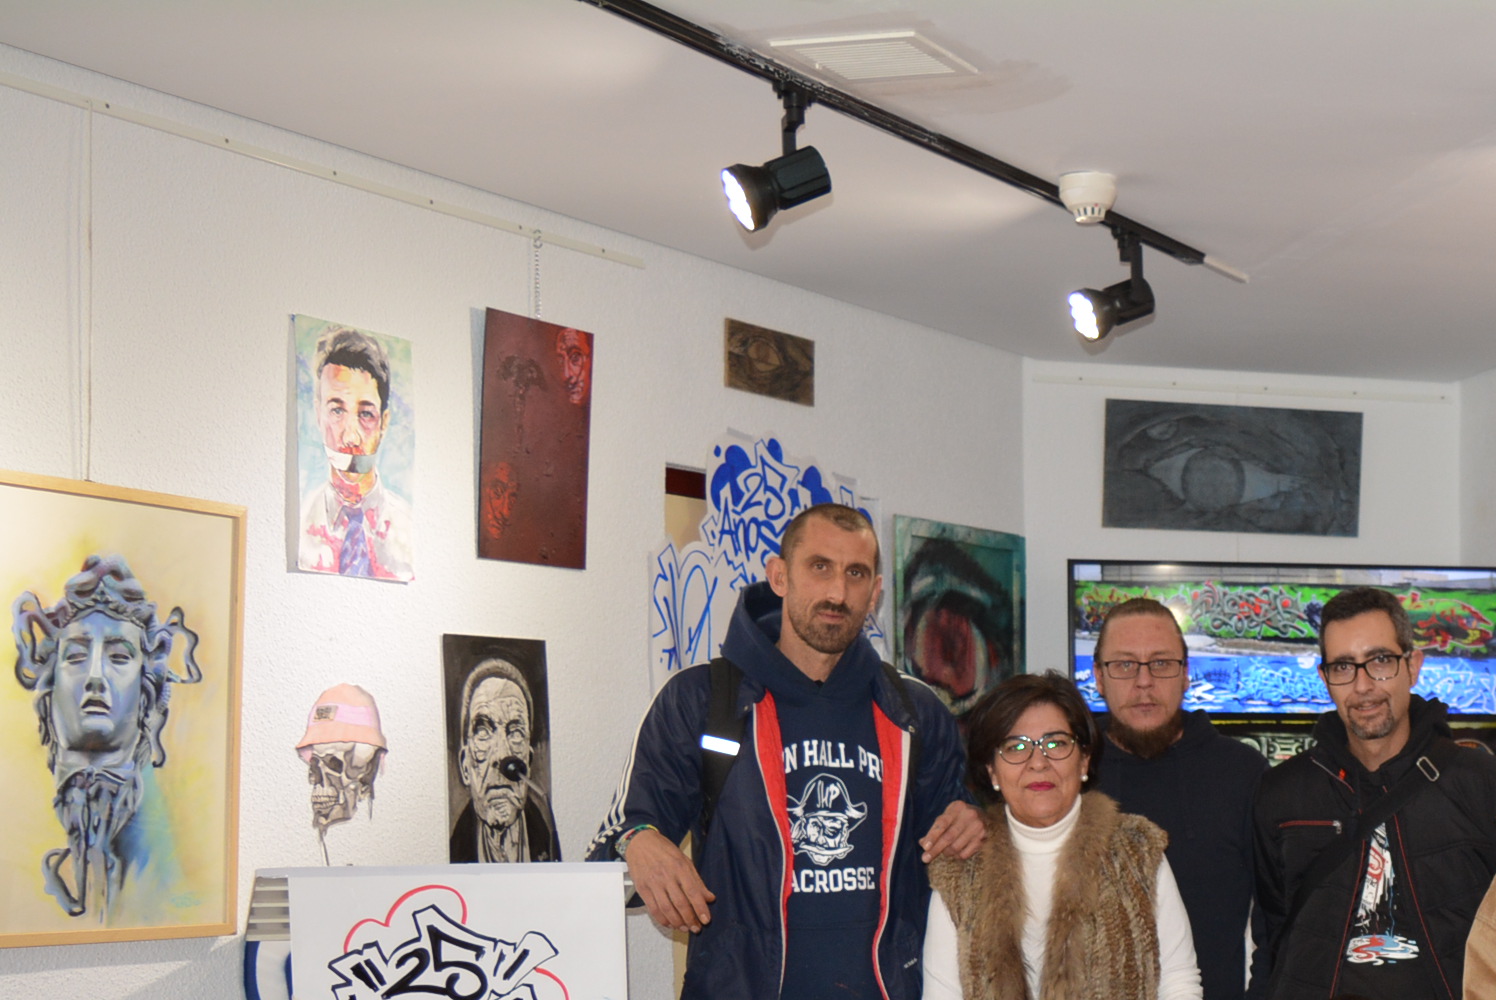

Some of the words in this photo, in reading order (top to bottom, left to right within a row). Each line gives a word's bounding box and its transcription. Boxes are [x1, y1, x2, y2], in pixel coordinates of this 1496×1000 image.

[782, 743, 798, 774] N
[803, 739, 855, 769] HALL
[858, 744, 884, 783] PR
[791, 866, 876, 893] ACROSSE
